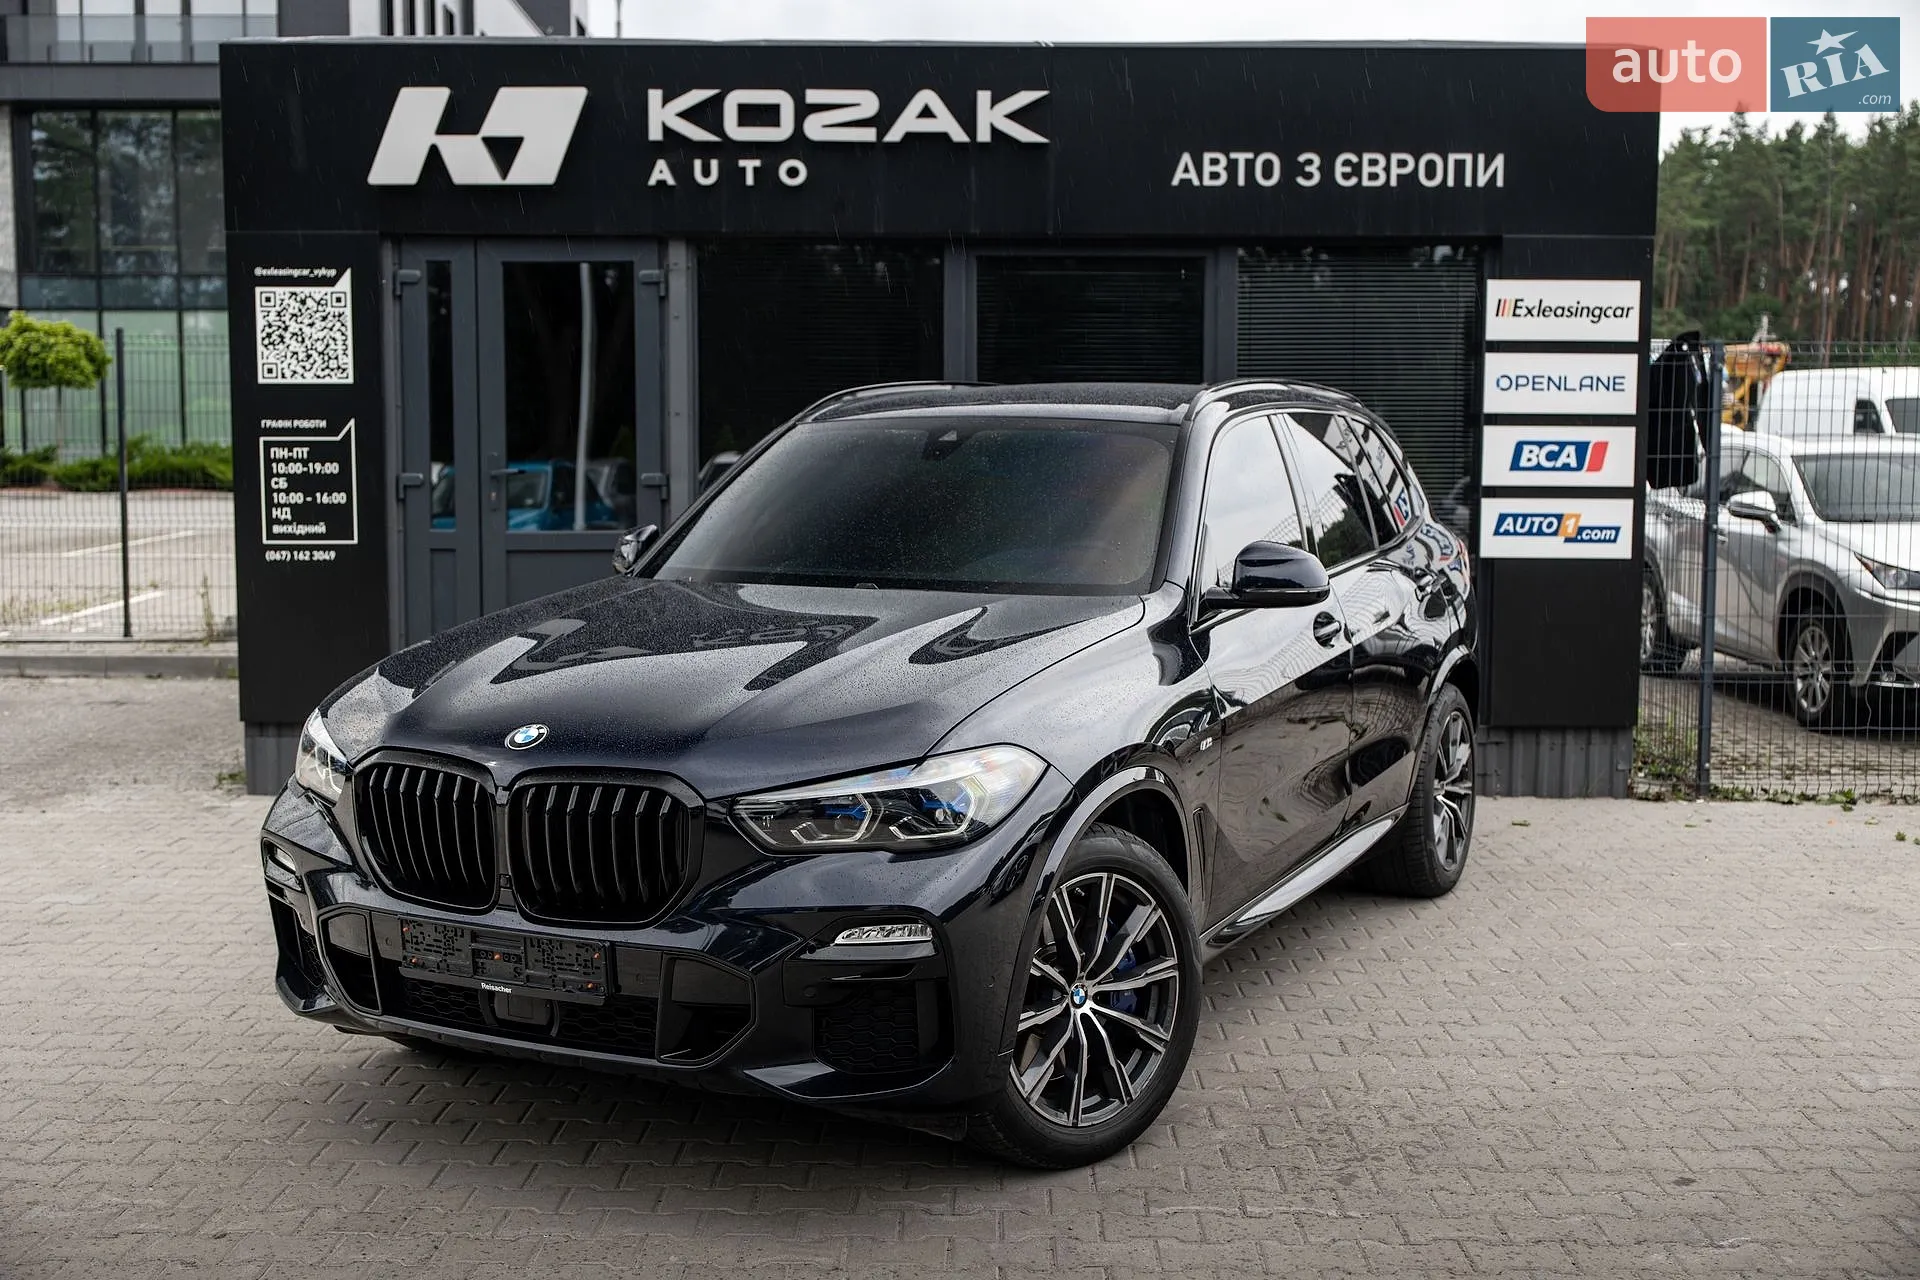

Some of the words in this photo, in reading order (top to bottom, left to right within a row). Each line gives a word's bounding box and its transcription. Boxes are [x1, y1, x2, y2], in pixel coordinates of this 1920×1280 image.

[648, 89, 1049, 142] KOZAK
[648, 159, 807, 186] AUTO
[1172, 152, 1280, 186] АВТО
[1335, 153, 1504, 187] ЄВРОПИ
[1512, 299, 1633, 323] Exleasingcar
[1496, 375, 1625, 391] OPENLANE
[270, 447, 309, 459] ПН-ПТ
[1518, 445, 1578, 468] BCA
[272, 462, 339, 474] 10:00-19:00
[271, 477, 288, 489] СБ
[273, 492, 304, 504] 10:00
[316, 492, 346, 504] 16:00
[272, 507, 291, 521] НД
[272, 522, 326, 535] вихідний
[265, 550, 291, 561] (067)
[293, 551, 310, 561] 162
[480, 982, 512, 993] Reisacher
